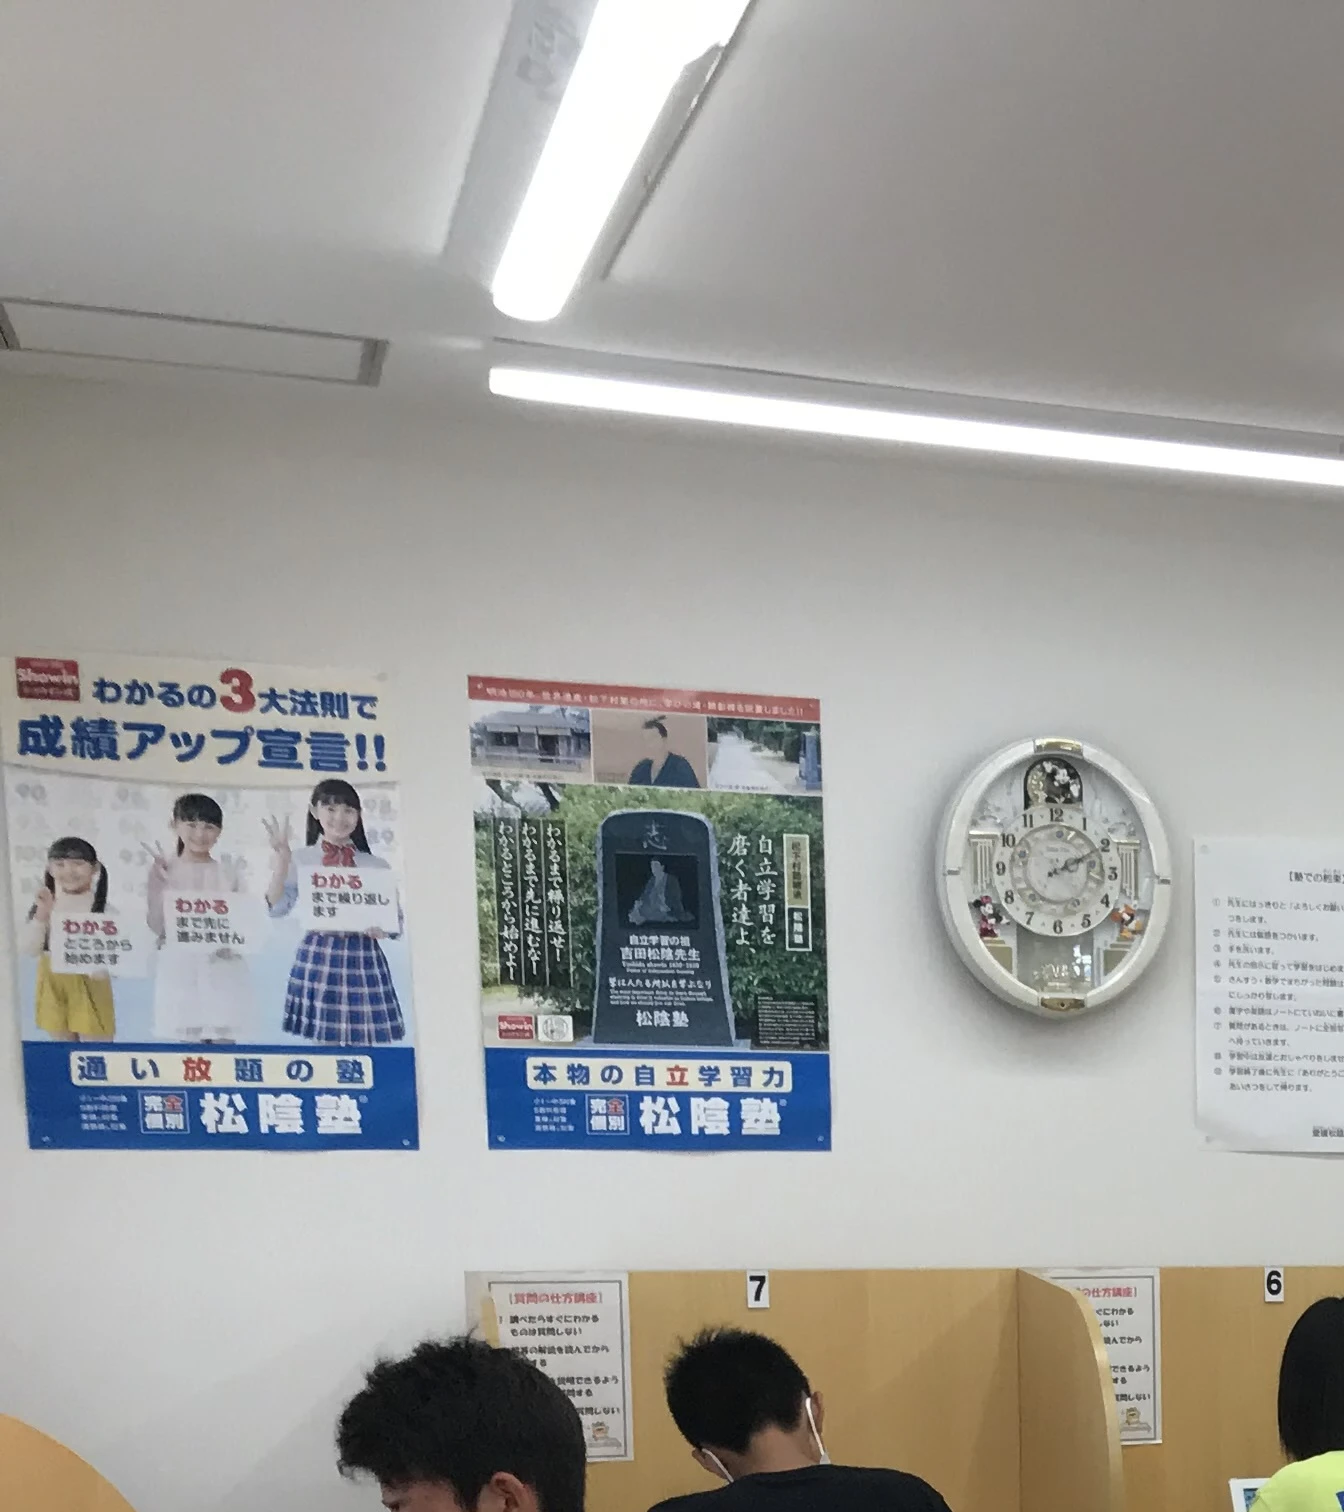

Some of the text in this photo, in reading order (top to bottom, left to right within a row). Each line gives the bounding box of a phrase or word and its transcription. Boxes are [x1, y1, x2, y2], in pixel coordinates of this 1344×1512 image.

[92, 667, 380, 720] わかるの3大法則で
[17, 713, 387, 773] 成績アップ宣言!!
[1023, 814, 1034, 828] 11
[1049, 808, 1064, 822] 12
[1082, 817, 1088, 831] 1
[1001, 833, 1016, 848] 10
[1100, 838, 1110, 852] 2
[996, 861, 1006, 876] 9
[1108, 867, 1118, 881] 3
[311, 873, 363, 890] わかる
[755, 834, 778, 945] 自立学習を
[1004, 890, 1015, 904] 8
[1100, 893, 1110, 907] 4
[175, 898, 229, 915] わかる
[312, 907, 339, 918] ます
[175, 916, 231, 929] まで先に
[1025, 911, 1035, 925] 7
[1082, 914, 1091, 928] 5
[63, 919, 118, 935] わかる
[1053, 920, 1063, 934] 6
[63, 938, 133, 951] ところから
[176, 931, 247, 945] 進みません
[629, 934, 691, 947] 自立学習の祖
[64, 952, 120, 965] 始めます
[620, 946, 701, 962] 吉田松陰先生
[635, 1009, 690, 1028] 松陰塾
[77, 1055, 366, 1084] 通い放題の塾
[532, 1062, 785, 1088] 本物の自立学習力
[748, 1275, 767, 1302] 7
[1266, 1269, 1282, 1296] 6
